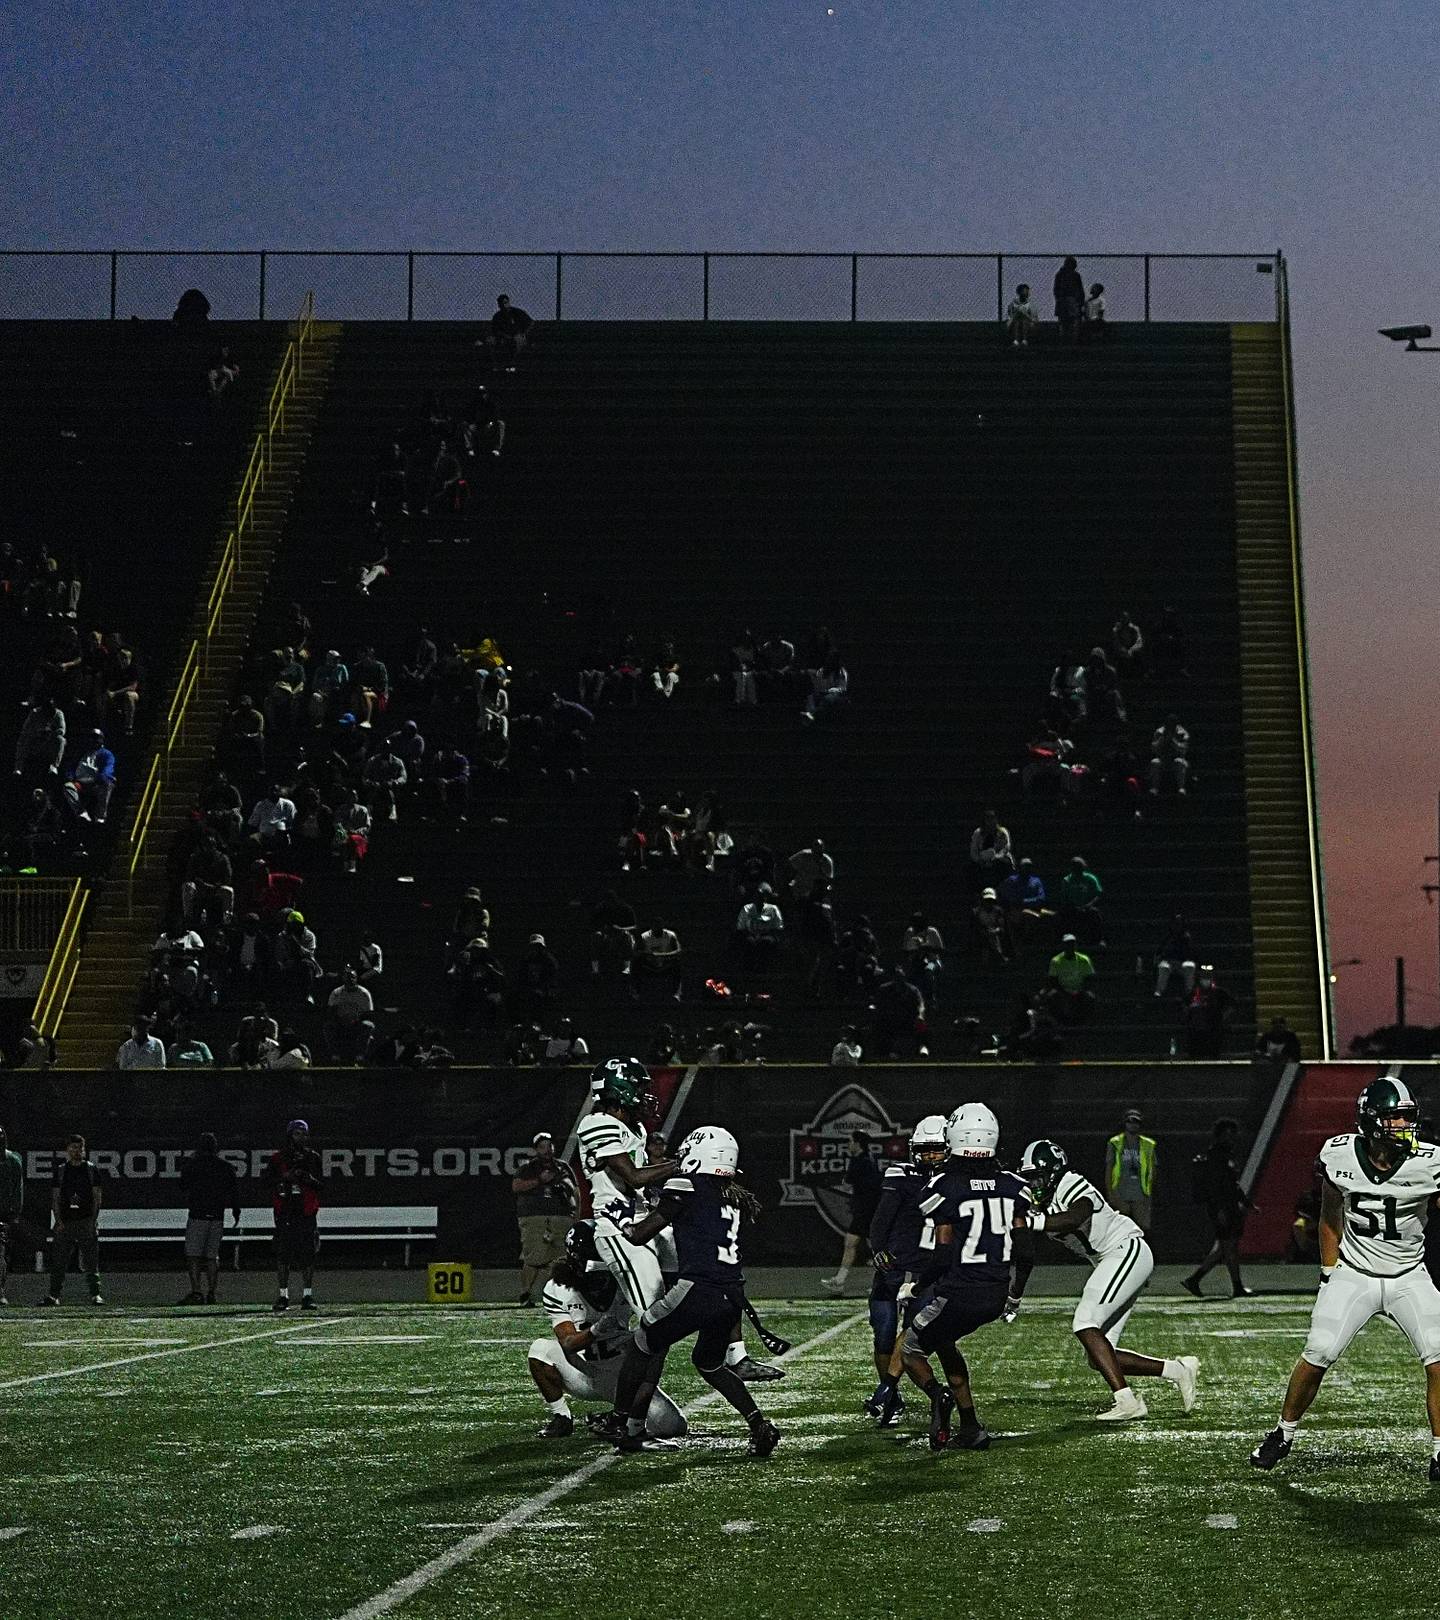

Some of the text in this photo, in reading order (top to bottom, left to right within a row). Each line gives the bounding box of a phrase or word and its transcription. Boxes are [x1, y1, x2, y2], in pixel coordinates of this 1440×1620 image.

[963, 1149, 991, 1158] Riddell
[1335, 1170, 1355, 1180] PSL
[1350, 1192, 1402, 1241] 51
[958, 1197, 1016, 1264] 24
[434, 1271, 464, 1294] 20
